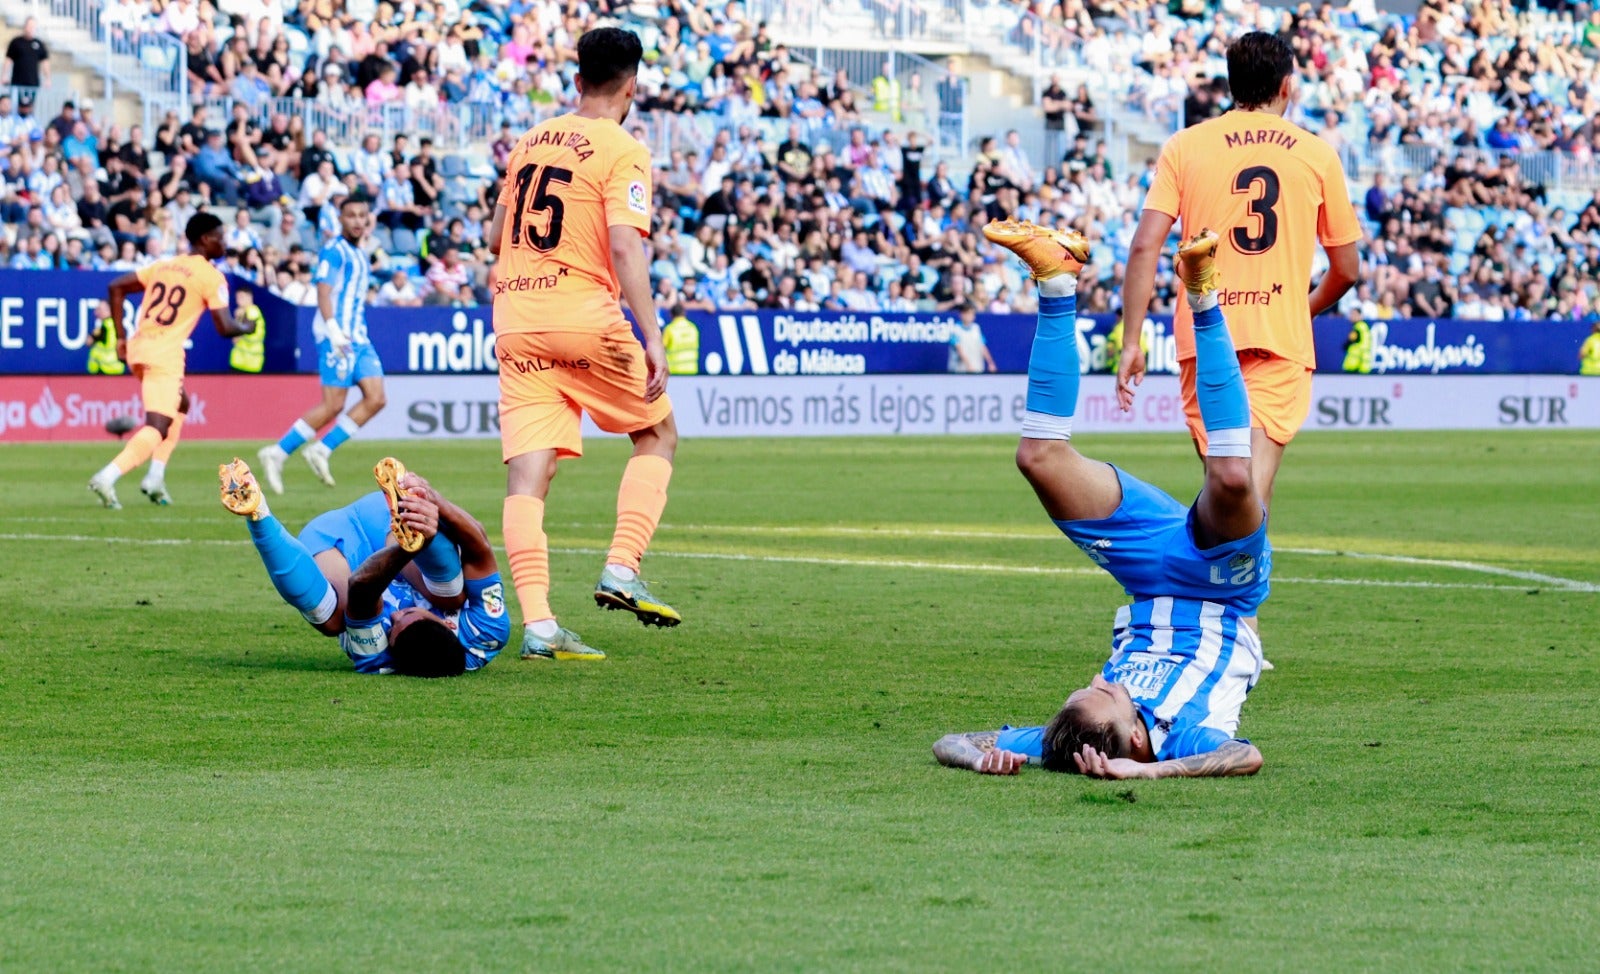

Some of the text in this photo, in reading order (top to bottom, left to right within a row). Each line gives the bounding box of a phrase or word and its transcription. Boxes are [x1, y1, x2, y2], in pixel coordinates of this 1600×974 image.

[564, 132, 595, 163] IBIZA
[1224, 129, 1298, 150] MARTÍN
[511, 162, 574, 254] 15
[1228, 165, 1281, 256] 3
[144, 281, 187, 327] 28
[773, 315, 954, 347] Diputación Provincial
[773, 349, 798, 374] de
[407, 401, 500, 434] SUR
[697, 386, 793, 425] Vamos
[803, 383, 861, 424] más
[870, 384, 935, 433] lejos
[944, 394, 1003, 431] para
[1316, 396, 1391, 426] SUR
[1498, 396, 1568, 425] SUR
